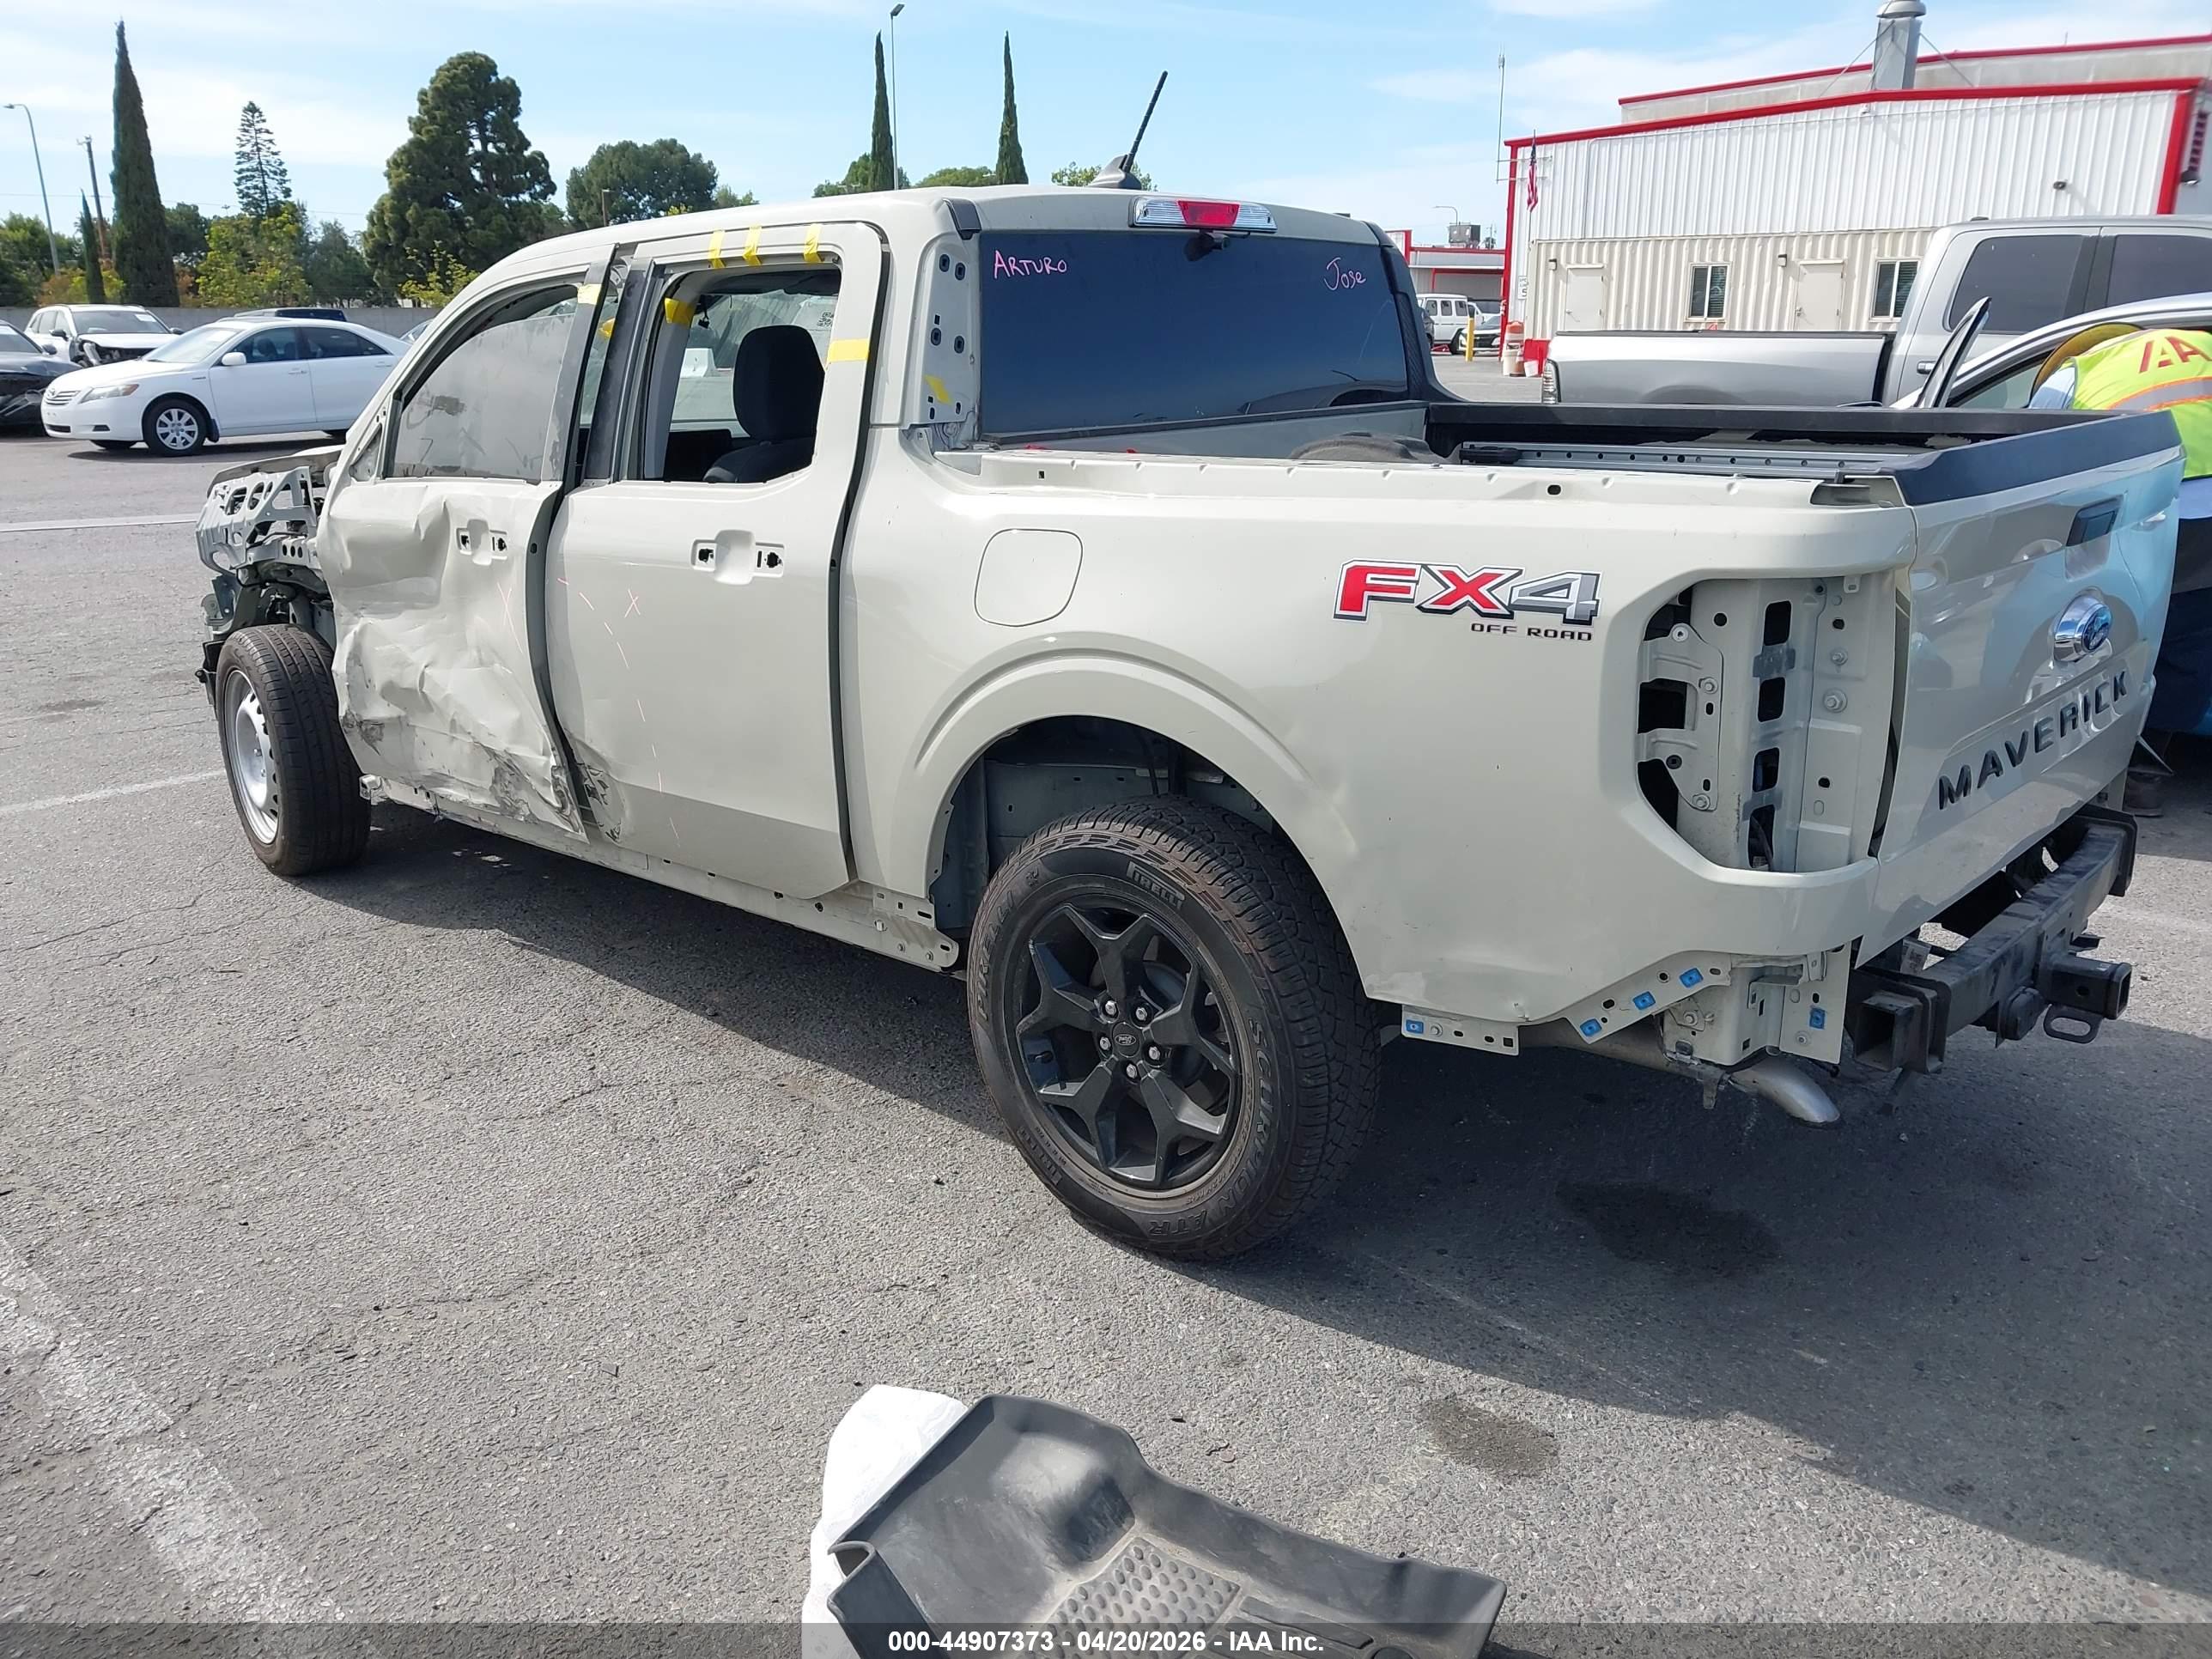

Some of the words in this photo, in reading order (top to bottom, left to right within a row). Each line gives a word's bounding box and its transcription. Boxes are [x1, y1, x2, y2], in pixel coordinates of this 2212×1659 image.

[994, 249, 1067, 279] ARTURO
[1323, 257, 1366, 291] Jose
[1333, 558, 1604, 627] FX4
[1471, 623, 1518, 635] OFF
[1527, 628, 1592, 642] ROAD
[1938, 670, 2129, 811] MAVERICK
[1126, 860, 1186, 909] PIRELLI
